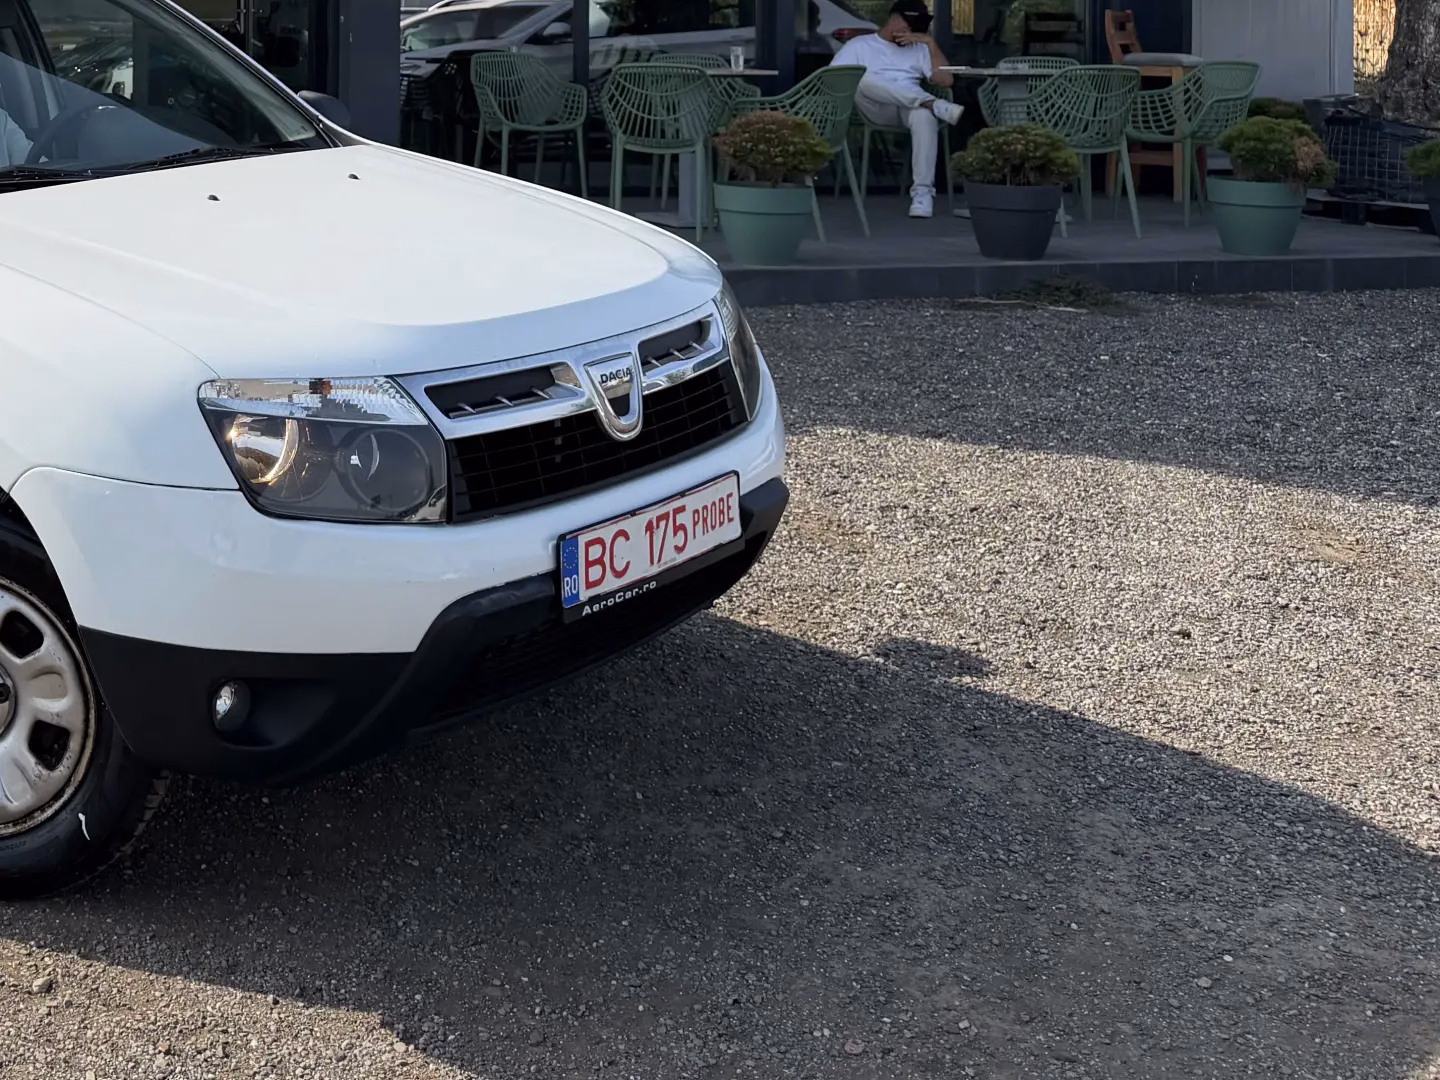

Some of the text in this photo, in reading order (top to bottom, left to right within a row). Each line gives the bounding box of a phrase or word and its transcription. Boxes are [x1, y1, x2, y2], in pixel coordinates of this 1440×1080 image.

[600, 366, 633, 384] DACIA
[584, 492, 735, 591] BC 175 PROBE
[564, 574, 578, 598] RO
[582, 580, 657, 617] AeroCar.ro
